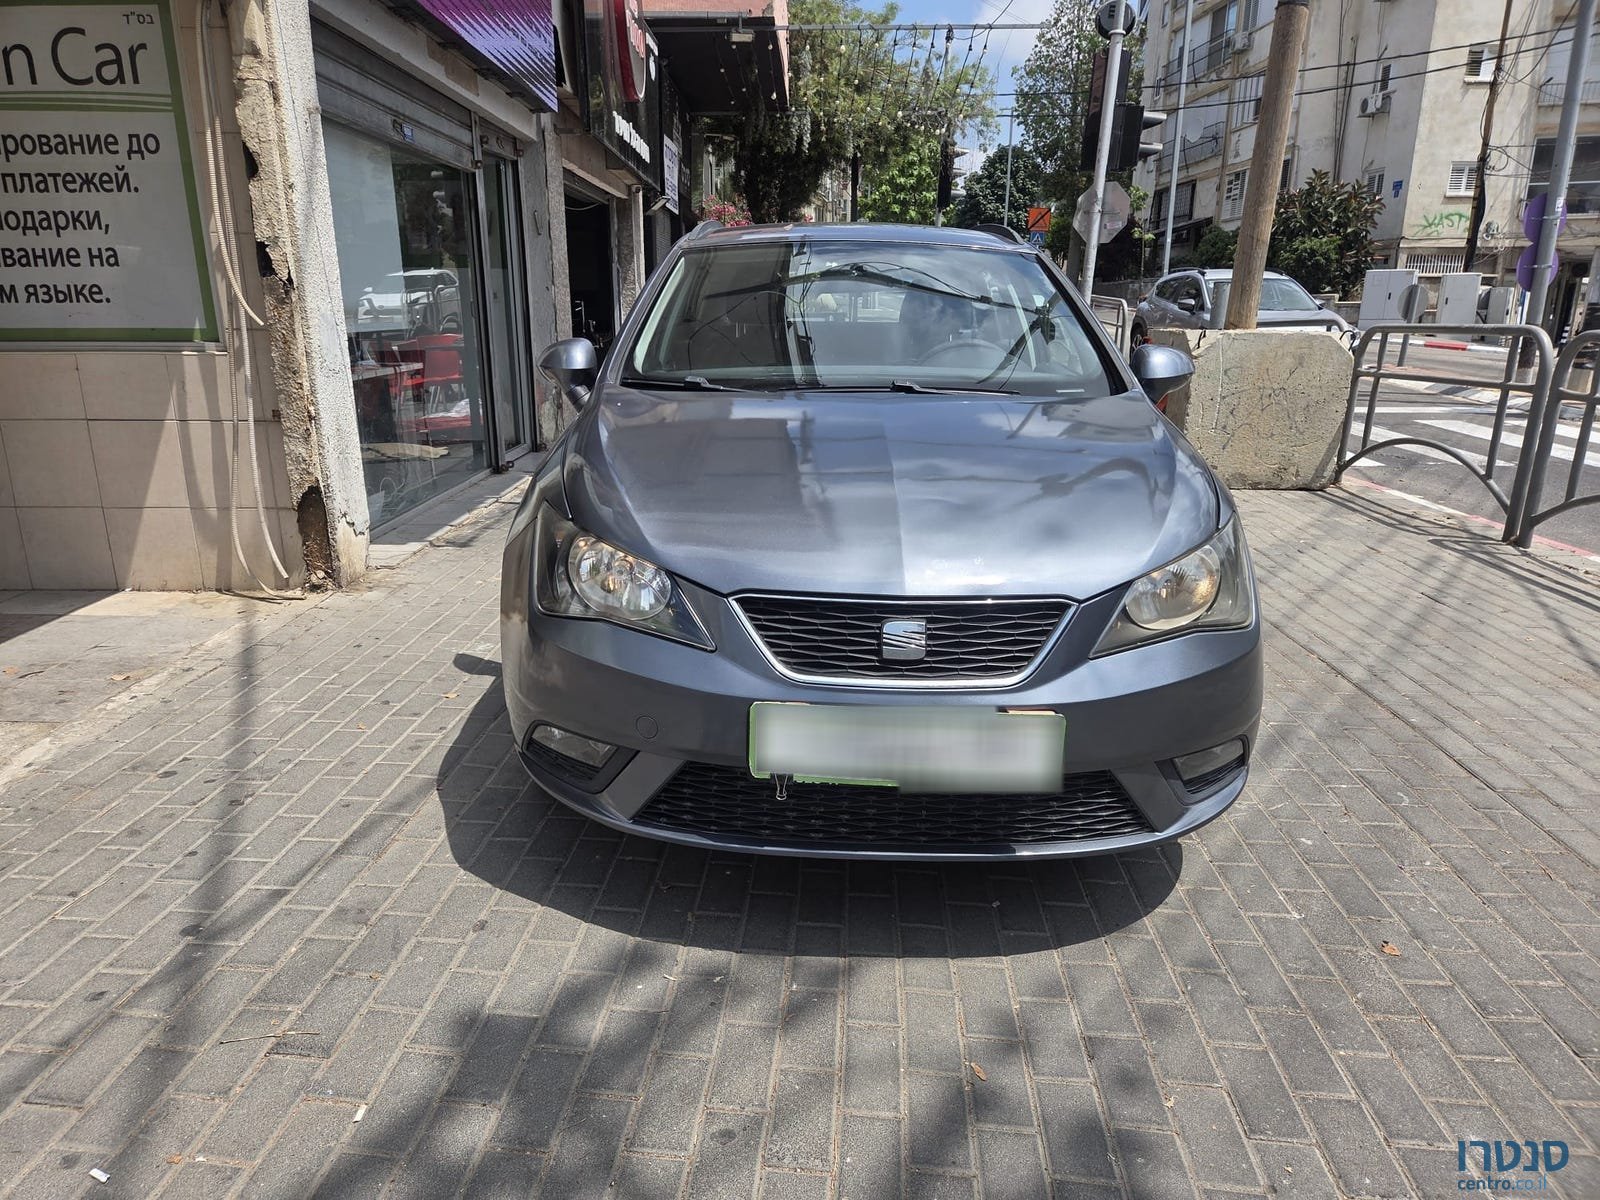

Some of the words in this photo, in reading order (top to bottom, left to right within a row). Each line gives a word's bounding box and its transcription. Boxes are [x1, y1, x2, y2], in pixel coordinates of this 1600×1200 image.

[51, 26, 148, 86] Car
[0, 133, 120, 163] рование
[127, 133, 161, 161] до
[1, 165, 139, 193] платежей.
[0, 247, 81, 268] вание
[88, 247, 120, 268] на
[24, 283, 111, 304] языке.
